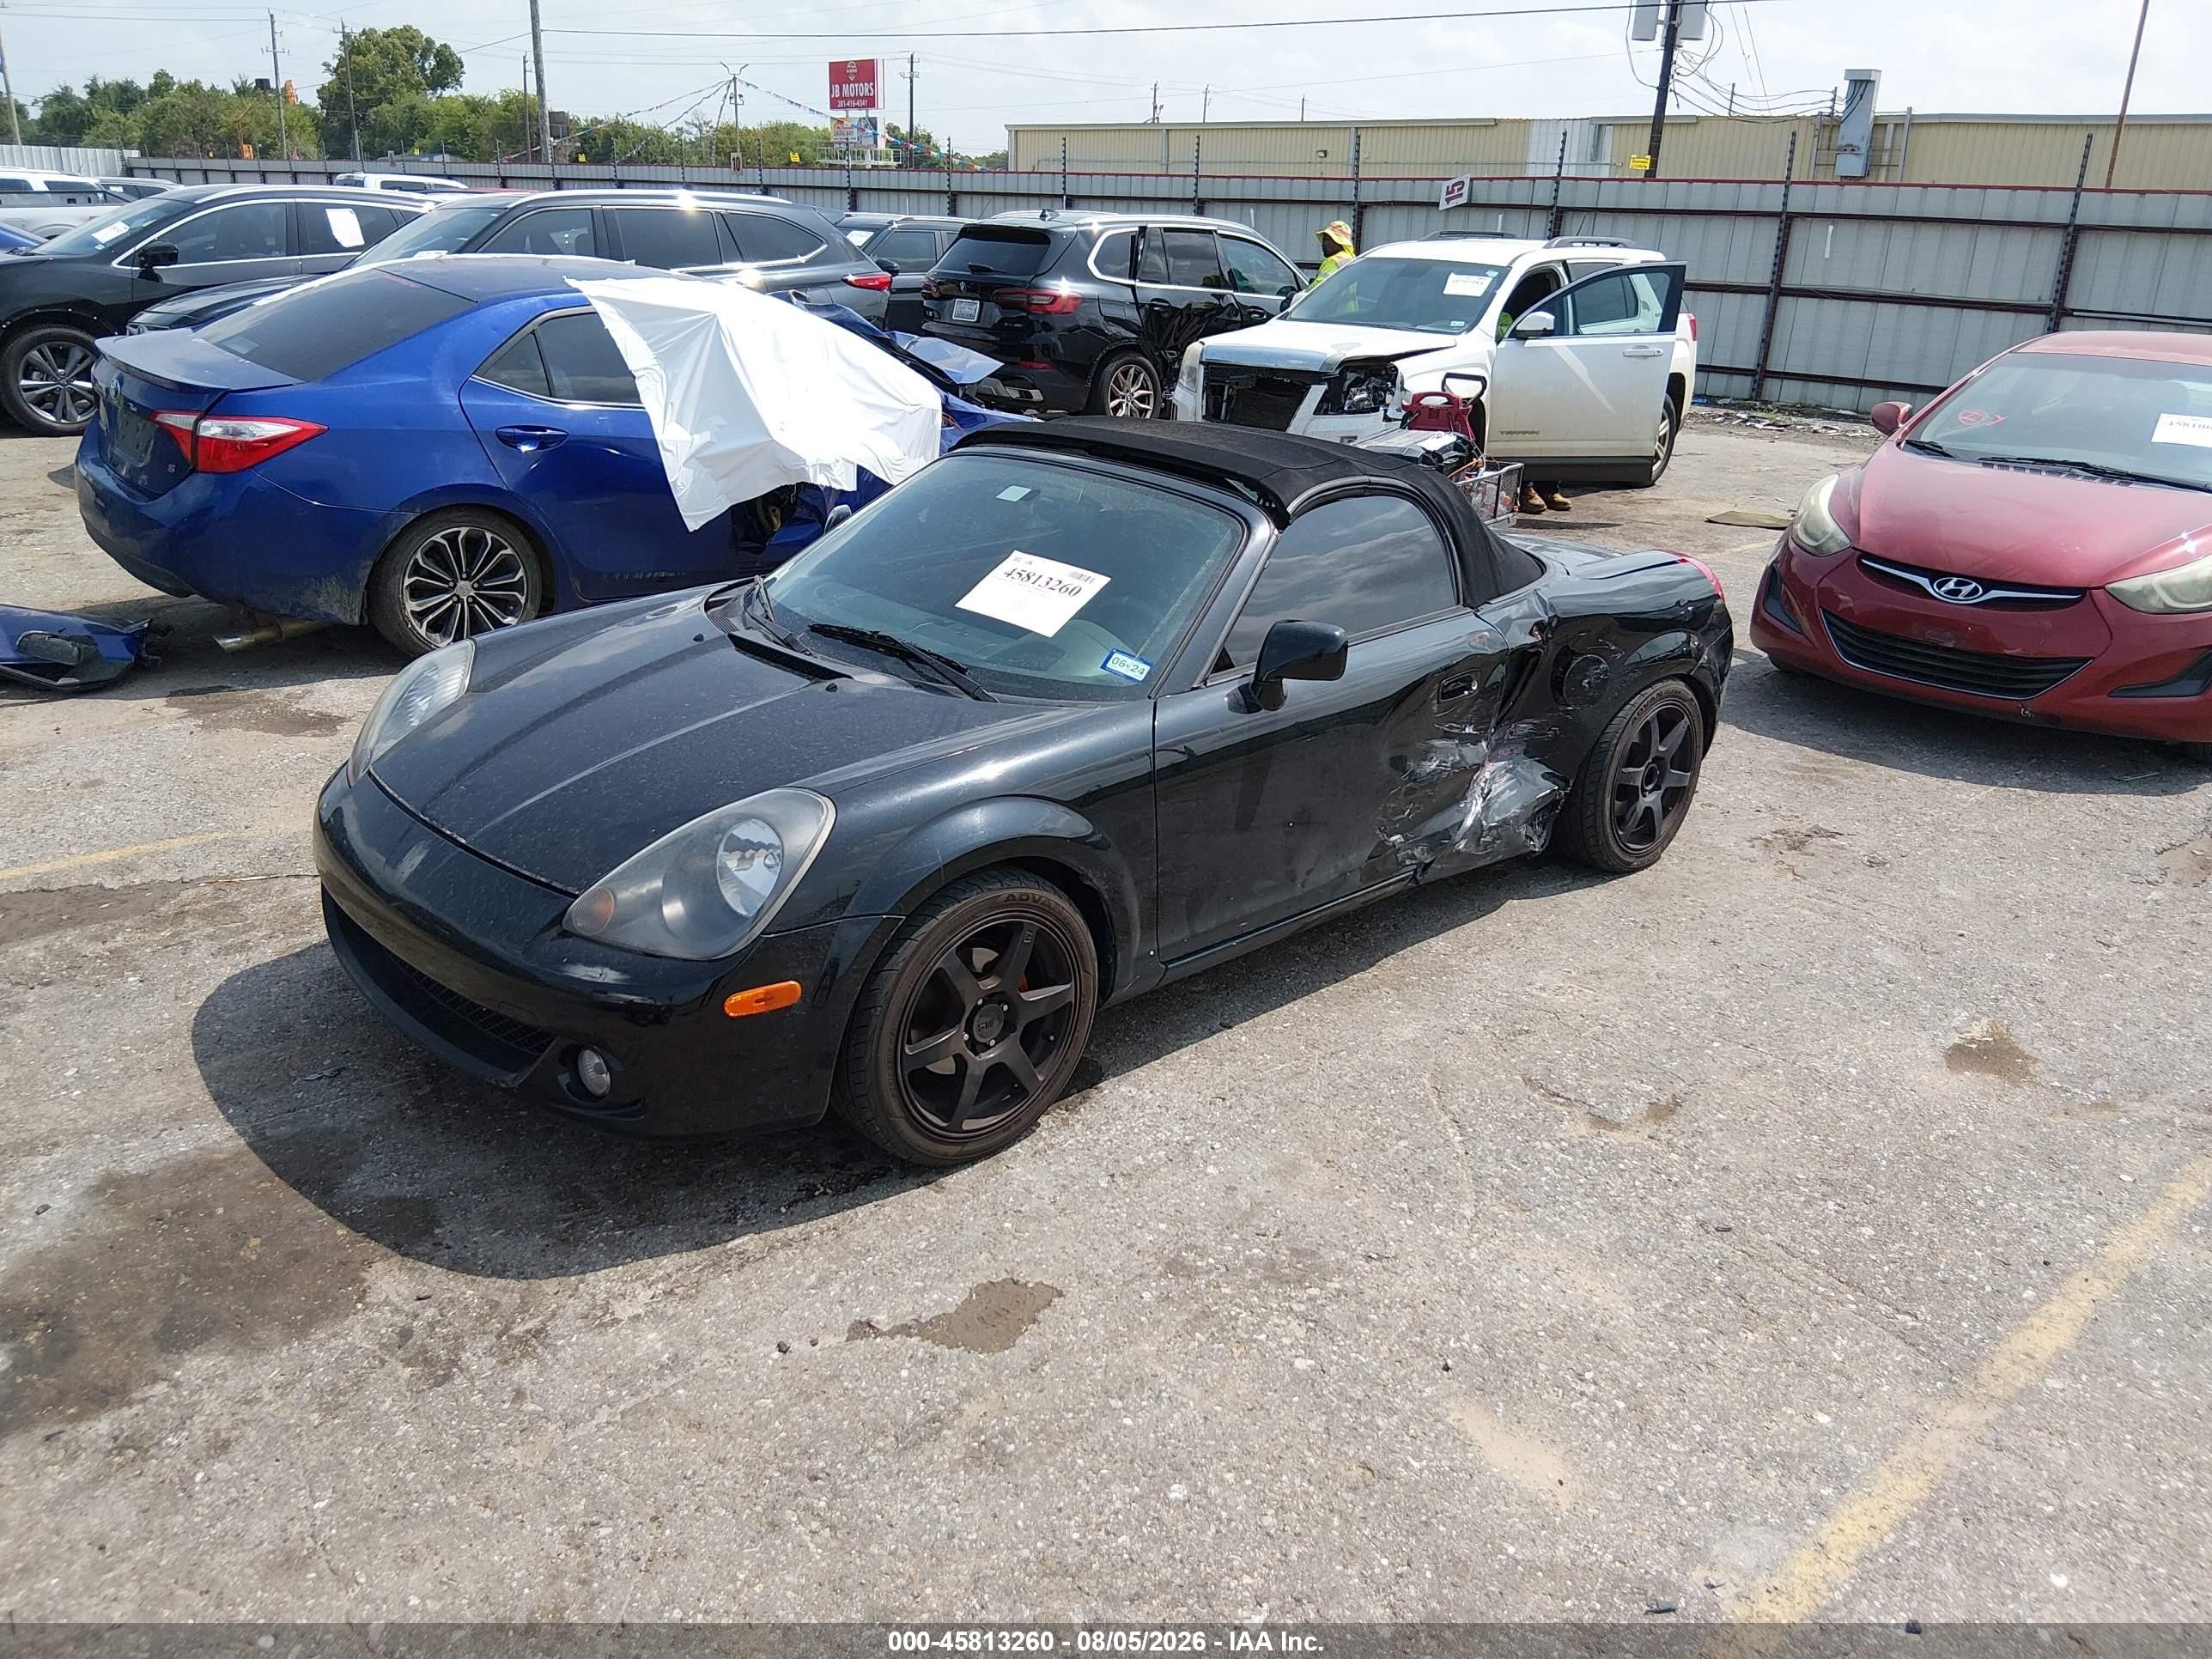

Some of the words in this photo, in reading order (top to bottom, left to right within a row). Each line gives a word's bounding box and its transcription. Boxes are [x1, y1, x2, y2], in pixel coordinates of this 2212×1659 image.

[831, 84, 840, 98] JB
[842, 82, 874, 98] MOTORS
[1004, 567, 1083, 599] 45813260
